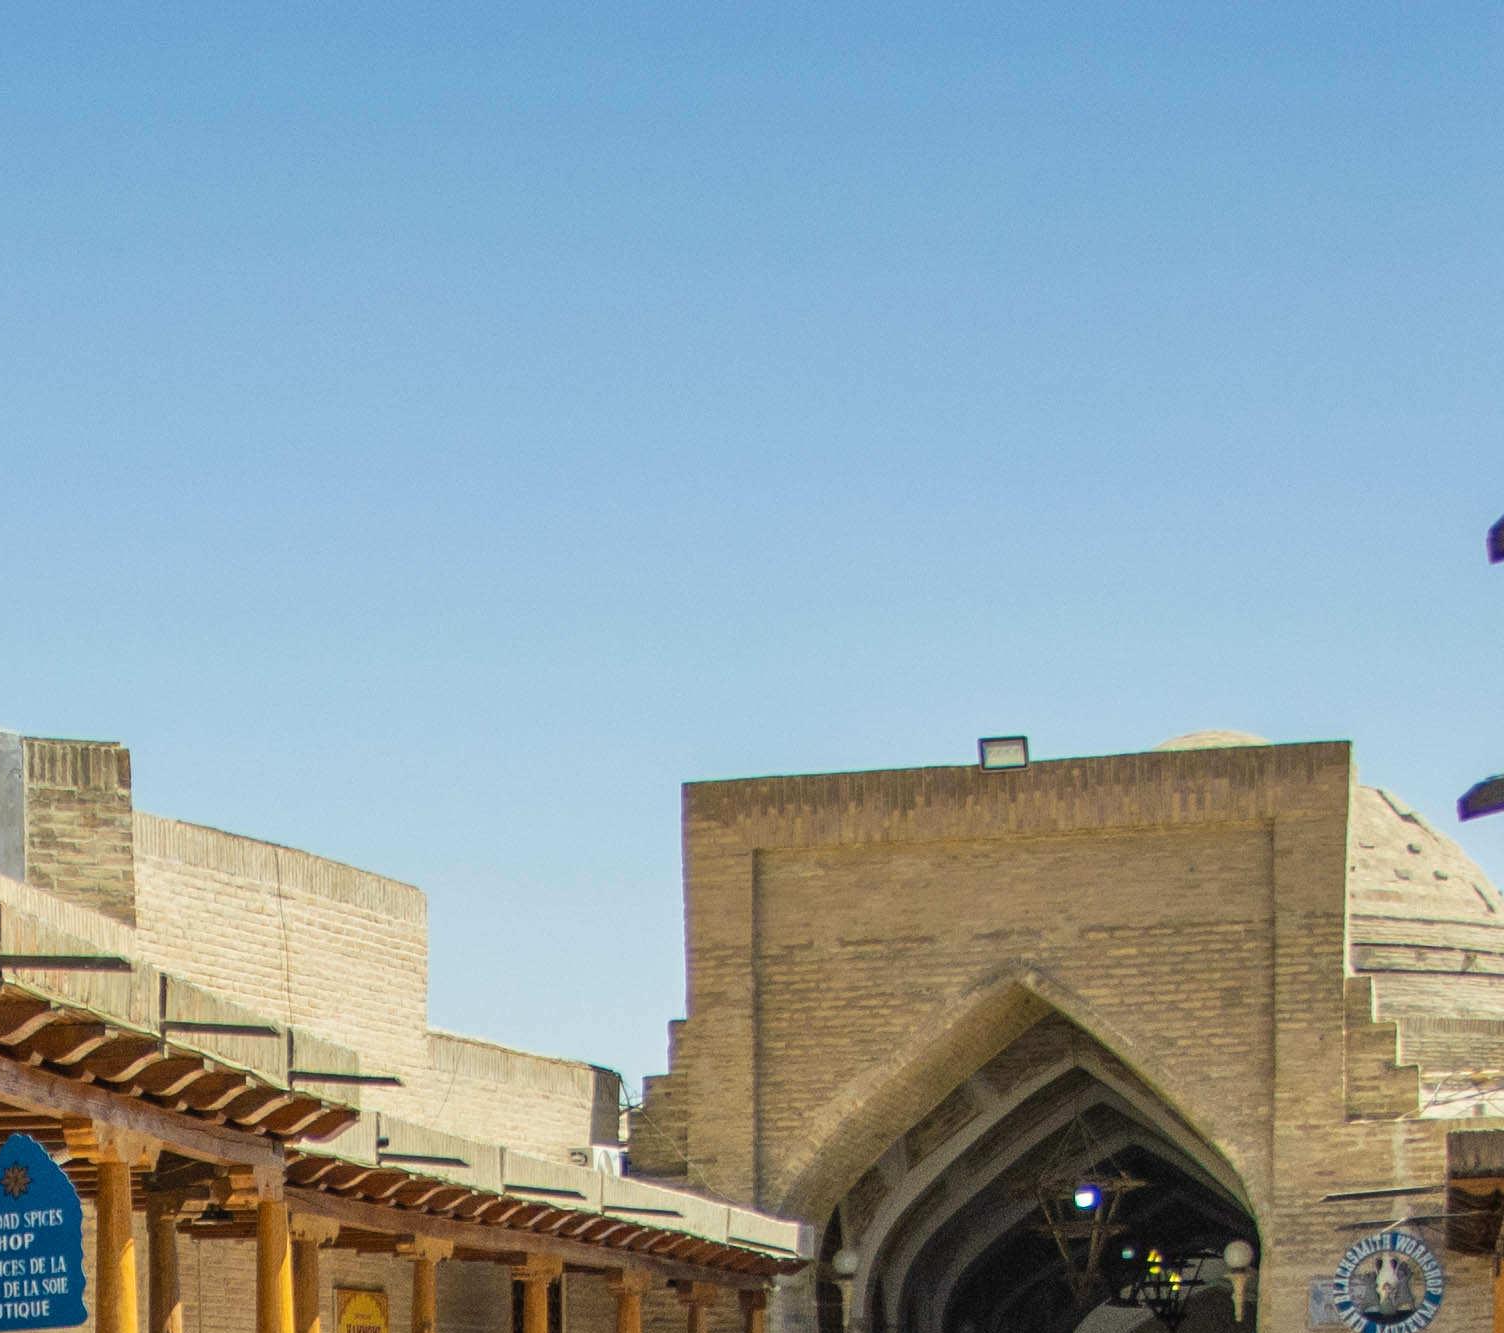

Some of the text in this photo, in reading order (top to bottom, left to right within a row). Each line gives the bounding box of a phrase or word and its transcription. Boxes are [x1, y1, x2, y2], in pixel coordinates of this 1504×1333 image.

[23, 1209, 63, 1229] SPICES
[30, 1257, 46, 1275] DE
[50, 1255, 67, 1274] LA
[1333, 1233, 1391, 1304] BLACKSMITH
[1396, 1234, 1443, 1296] WORKSHOP
[3, 1281, 20, 1298] DE
[23, 1280, 40, 1297] LA
[42, 1277, 68, 1296] SOIE
[1339, 1306, 1368, 1333] AND
